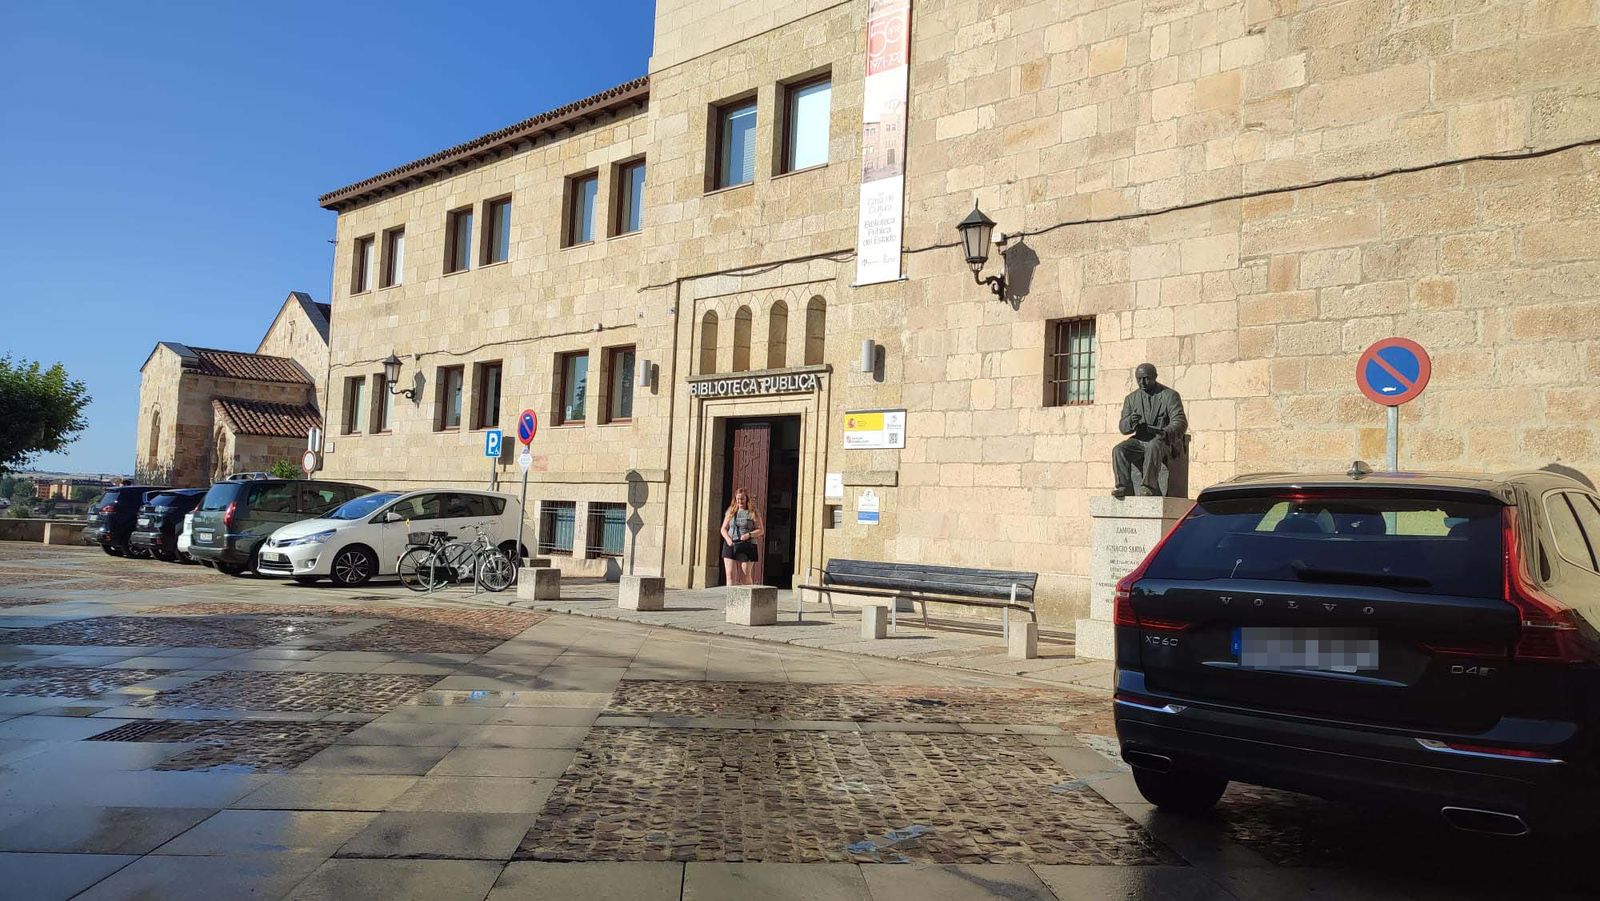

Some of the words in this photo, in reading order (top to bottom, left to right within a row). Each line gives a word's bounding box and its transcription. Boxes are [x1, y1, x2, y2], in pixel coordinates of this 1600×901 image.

[870, 16, 904, 57] 50
[868, 204, 892, 214] Cultura
[864, 217, 895, 228] Biblioteca
[863, 235, 873, 246] del
[874, 234, 896, 244] Estado
[690, 378, 757, 396] BIBLIOTECA
[488, 432, 498, 454] P
[1219, 596, 1375, 615] VOLVO
[1145, 635, 1179, 646] XC60
